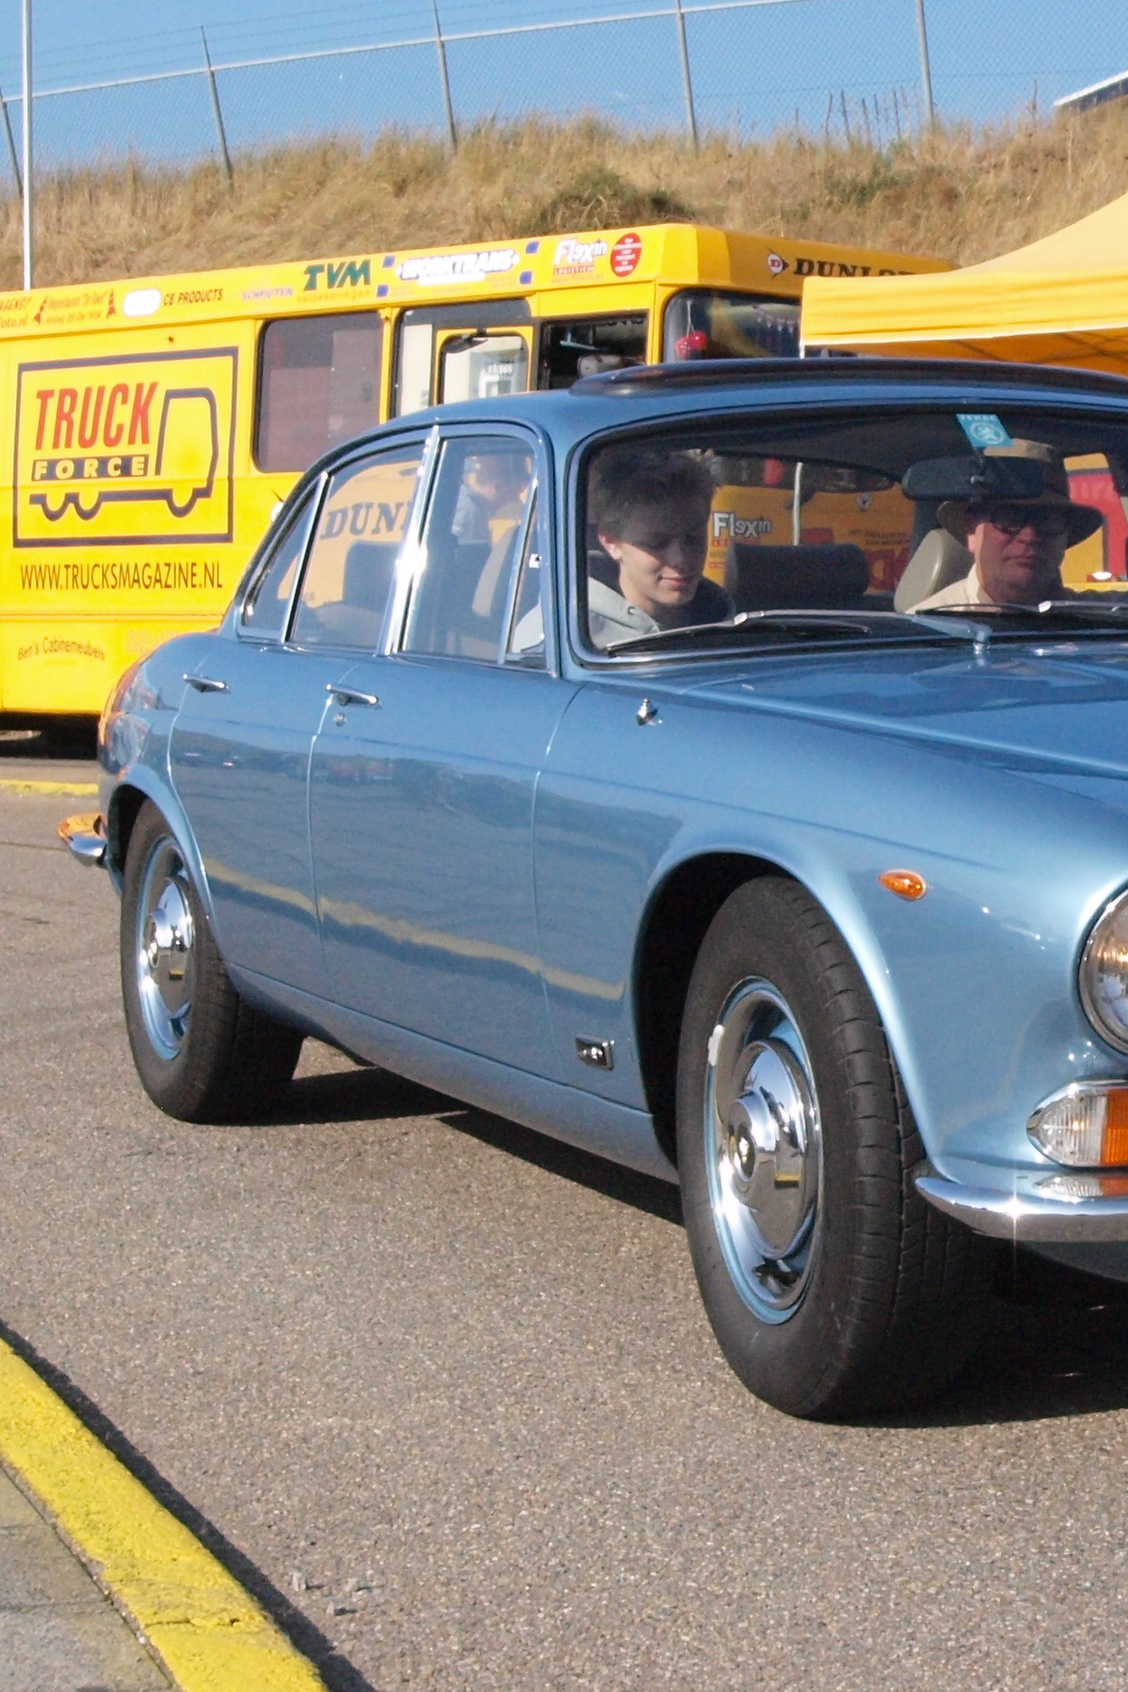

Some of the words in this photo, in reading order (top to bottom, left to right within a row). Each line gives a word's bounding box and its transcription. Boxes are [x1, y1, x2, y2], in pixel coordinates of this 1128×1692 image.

[303, 259, 371, 291] TVM
[177, 288, 223, 304] PRODUCTS
[35, 381, 158, 451] TRUCK
[34, 455, 146, 481] FORCE
[713, 512, 771, 538] Flexin
[20, 562, 223, 590] WWW.TRUCKSMAGAZINE.NL
